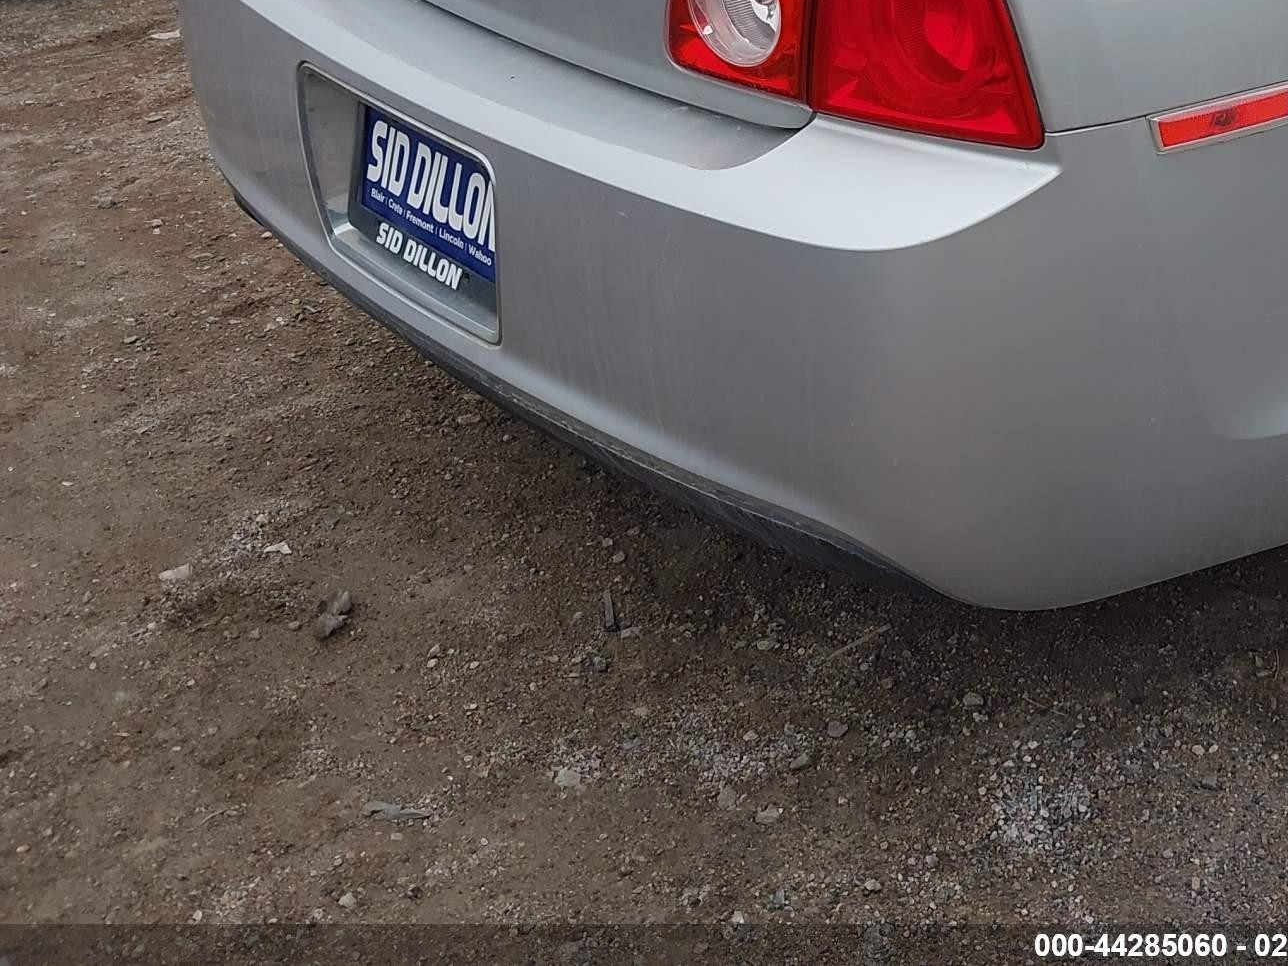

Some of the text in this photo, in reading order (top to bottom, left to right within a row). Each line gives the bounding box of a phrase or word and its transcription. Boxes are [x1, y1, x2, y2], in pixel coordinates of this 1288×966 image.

[366, 119, 410, 197] SID
[371, 187, 385, 203] Blair
[406, 209, 435, 233] Fremont
[439, 227, 464, 250] Lincoln
[468, 244, 492, 266] Wahoo
[376, 222, 463, 291] SID DILLON
